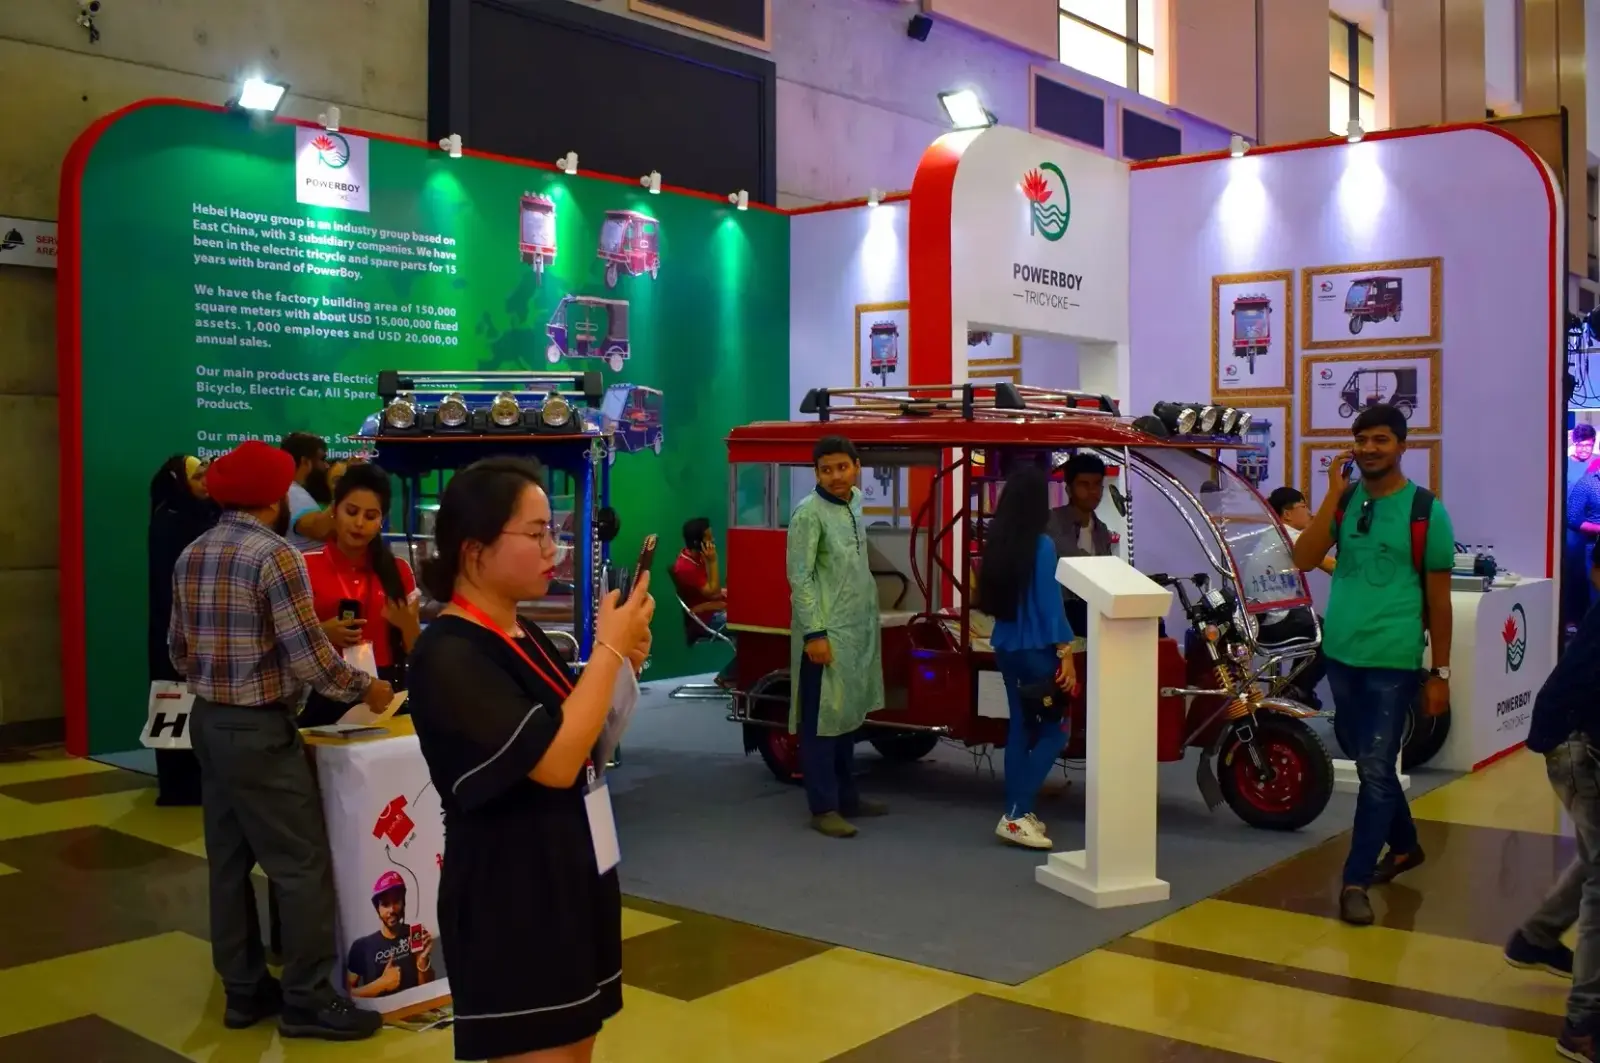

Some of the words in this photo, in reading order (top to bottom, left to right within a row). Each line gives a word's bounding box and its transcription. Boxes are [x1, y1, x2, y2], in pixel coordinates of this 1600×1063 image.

[305, 178, 360, 193] POWERBOY
[192, 202, 227, 217] Hebei
[230, 208, 267, 223] Haoyu
[270, 215, 304, 228] group
[306, 217, 315, 228] is
[379, 229, 410, 242] group
[412, 231, 442, 244] based
[443, 237, 456, 246] on
[192, 219, 219, 232] East
[221, 222, 258, 238] China,
[261, 228, 286, 240] with
[288, 231, 296, 241] 3
[298, 233, 355, 250] subsidiary
[356, 241, 415, 256] companies.
[416, 246, 432, 258] We
[433, 247, 457, 260] have
[193, 234, 224, 249] been
[226, 238, 238, 250] in
[240, 241, 260, 253] the
[262, 243, 304, 258] electric
[306, 248, 347, 263] tricycle
[348, 255, 368, 265] and
[370, 258, 399, 269] spare
[400, 259, 427, 272] parts
[428, 261, 443, 273] for
[445, 264, 457, 274] 15
[193, 253, 226, 265] years
[229, 256, 254, 268] with
[256, 258, 290, 271] brand
[292, 262, 305, 273] of
[306, 263, 363, 281] PowerBoy.
[1013, 262, 1083, 291] POWERBOY
[194, 283, 214, 296] We
[217, 285, 249, 299] have
[251, 288, 272, 301] the
[275, 291, 319, 307] factory
[322, 295, 371, 312] building
[373, 302, 398, 312] area
[400, 304, 412, 313] of
[415, 305, 457, 317] 150,000
[1025, 289, 1069, 310] TRICYCKE
[194, 302, 237, 314] square
[240, 305, 282, 317] meters
[284, 309, 310, 320] with
[312, 310, 346, 323] about
[348, 313, 372, 324] USD
[375, 316, 432, 329] 15,000,000
[434, 320, 459, 332] fixed
[245, 321, 281, 333] 1,000
[284, 325, 350, 338] employees
[353, 330, 374, 340] and
[378, 331, 401, 341] USD
[195, 335, 237, 346] annual
[239, 336, 272, 348] sales.
[196, 365, 220, 377] Our
[223, 368, 254, 378] main
[257, 369, 309, 381] products
[312, 373, 330, 382] are
[333, 372, 374, 384] Electric
[196, 381, 246, 395] Bicycle,
[249, 384, 296, 396] Electric
[299, 387, 321, 398] Car,
[325, 387, 340, 398] All
[344, 388, 376, 400] Spare
[197, 430, 222, 441] Our
[226, 432, 259, 442] main
[1496, 690, 1532, 718] POWERBOY
